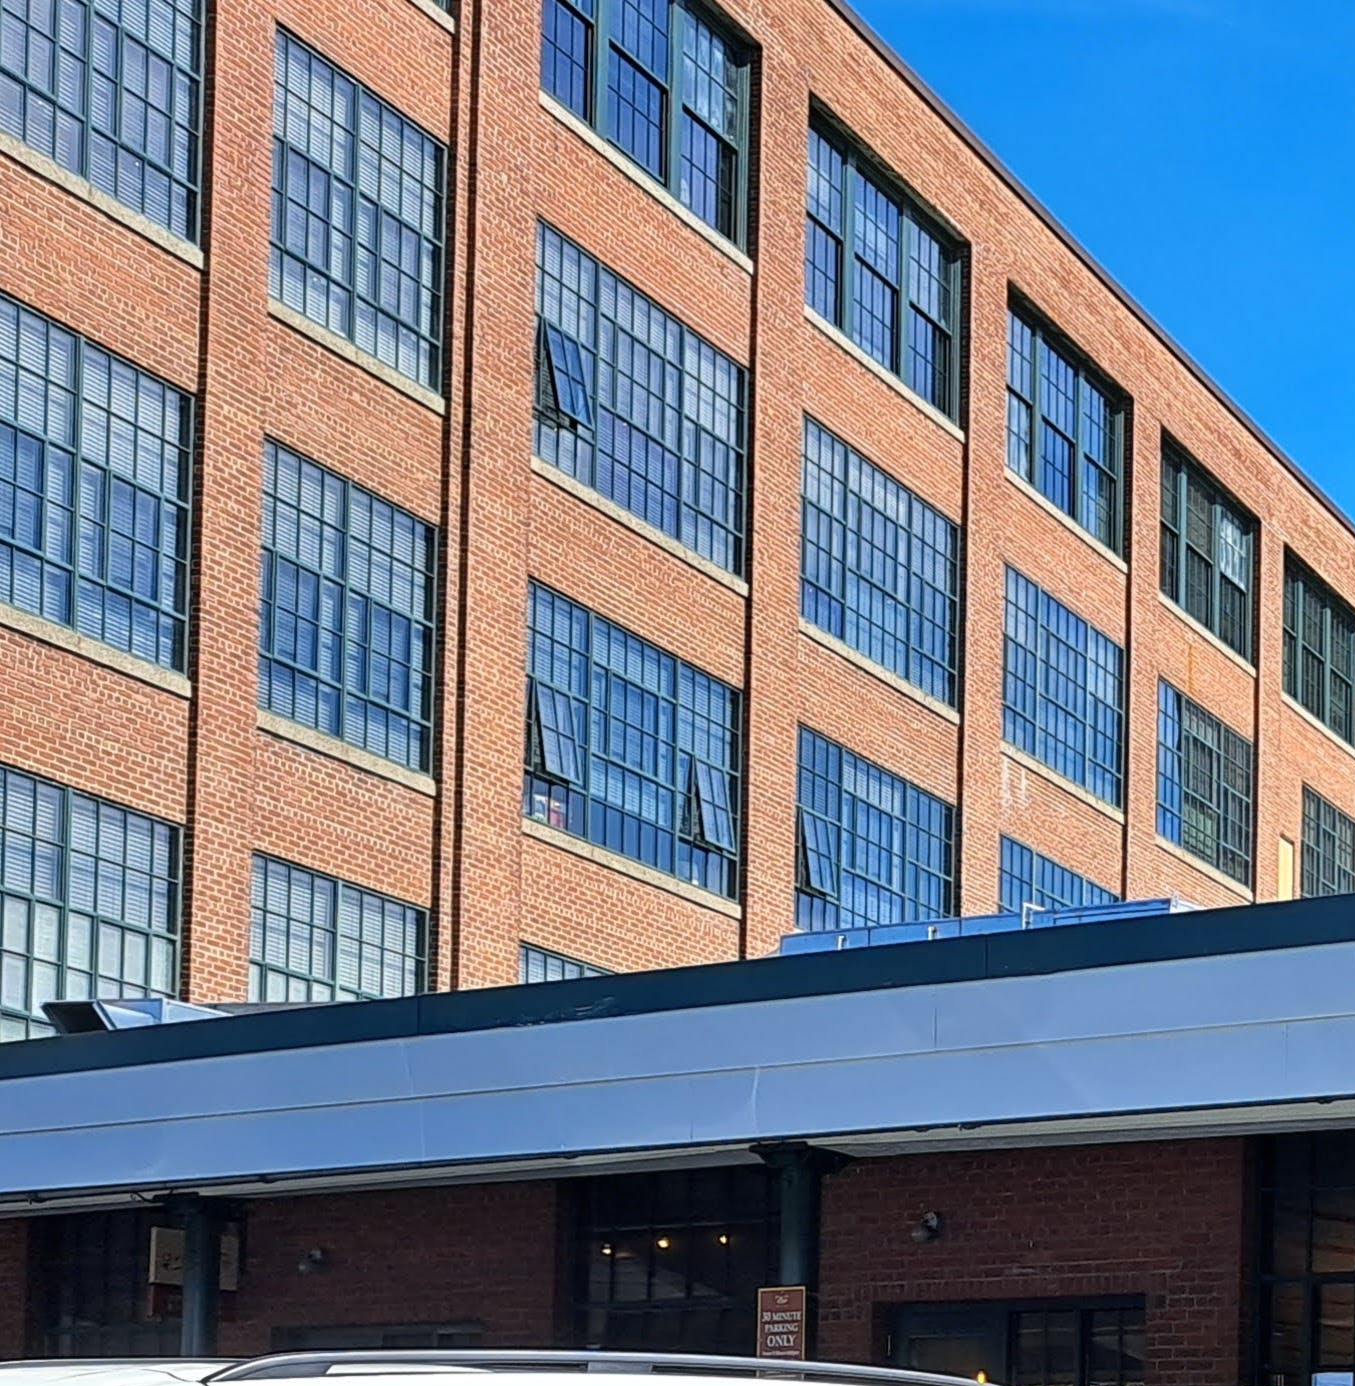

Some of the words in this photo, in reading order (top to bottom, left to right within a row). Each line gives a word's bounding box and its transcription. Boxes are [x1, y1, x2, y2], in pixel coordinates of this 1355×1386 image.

[772, 1311, 802, 1320] MINUTE
[764, 1323, 799, 1333] PARKING
[767, 1334, 796, 1347] ONLY
